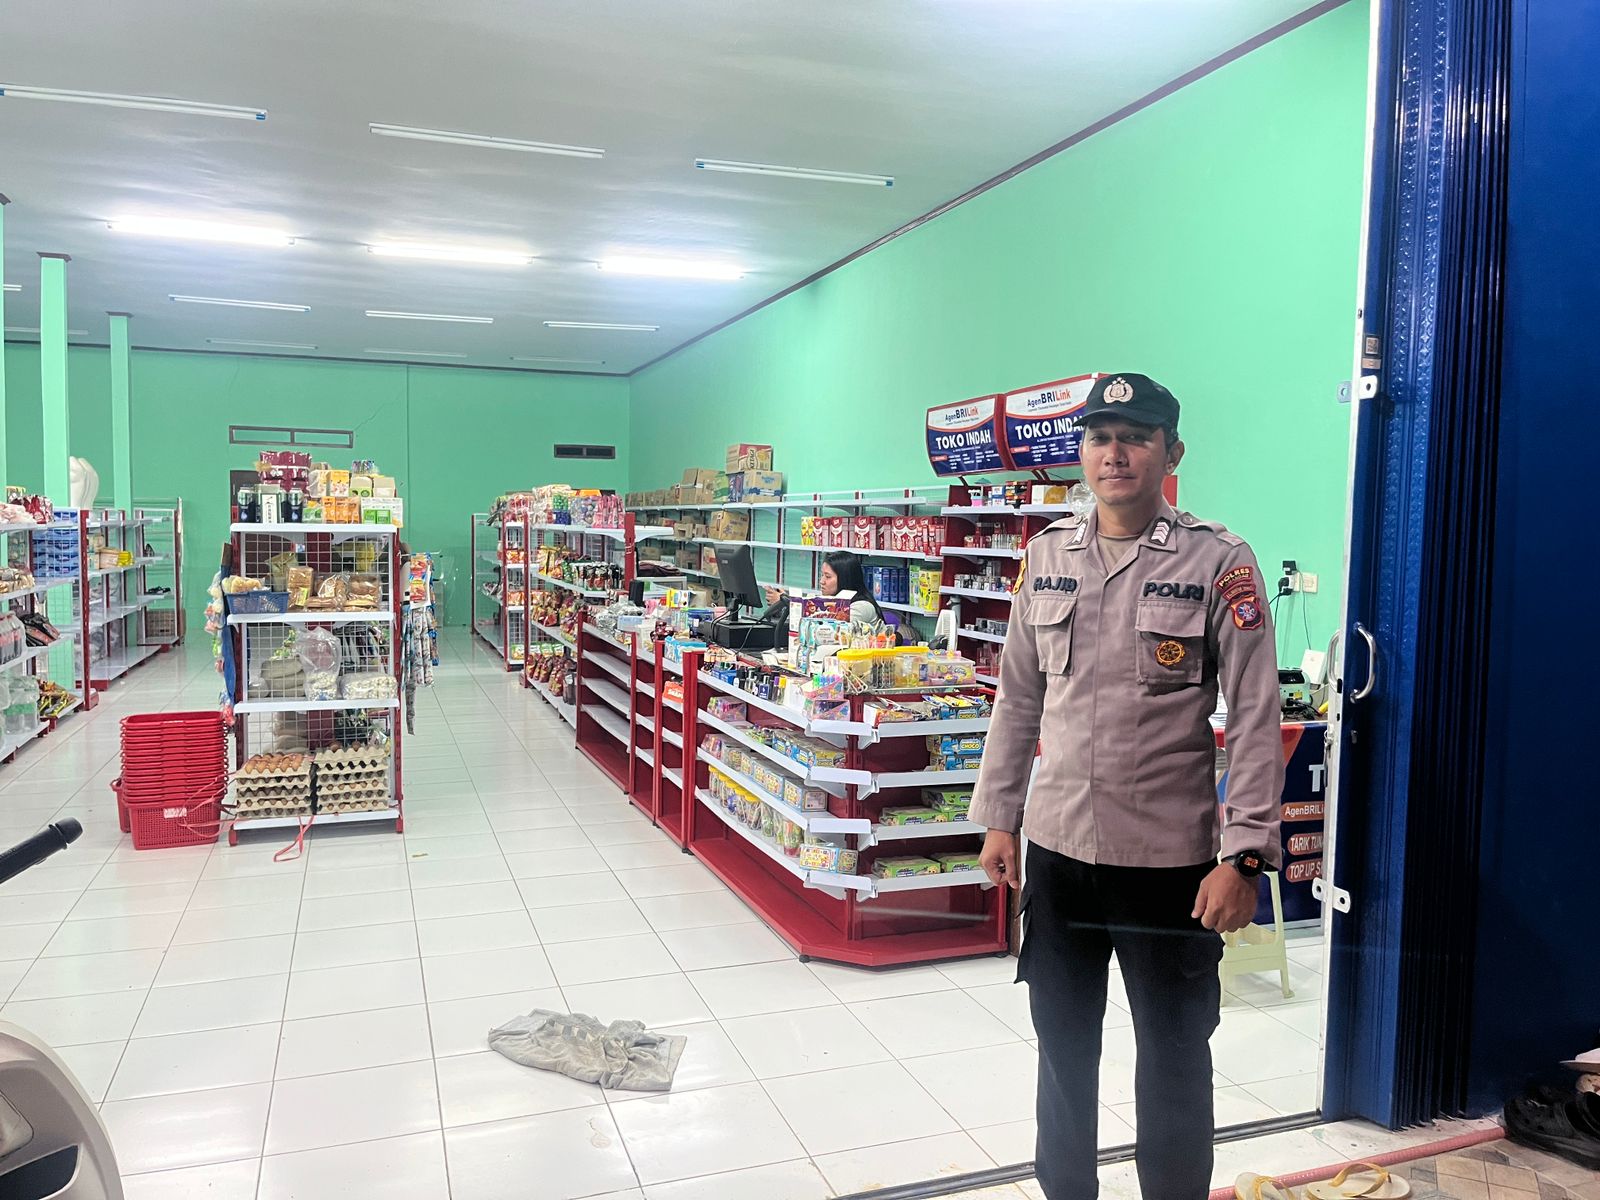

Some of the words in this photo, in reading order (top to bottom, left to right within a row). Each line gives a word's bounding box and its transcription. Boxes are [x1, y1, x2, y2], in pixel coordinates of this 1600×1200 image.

[1027, 388, 1071, 408] AgenBRILink
[935, 433, 964, 450] TOKO
[965, 429, 991, 446] INDAH
[1015, 421, 1051, 440] TOKO
[1143, 582, 1205, 601] POLRI
[1284, 804, 1324, 818] AgenBRILi
[1290, 837, 1311, 852] TARIK
[1290, 865, 1304, 879] TOP
[1305, 863, 1315, 877] UP
